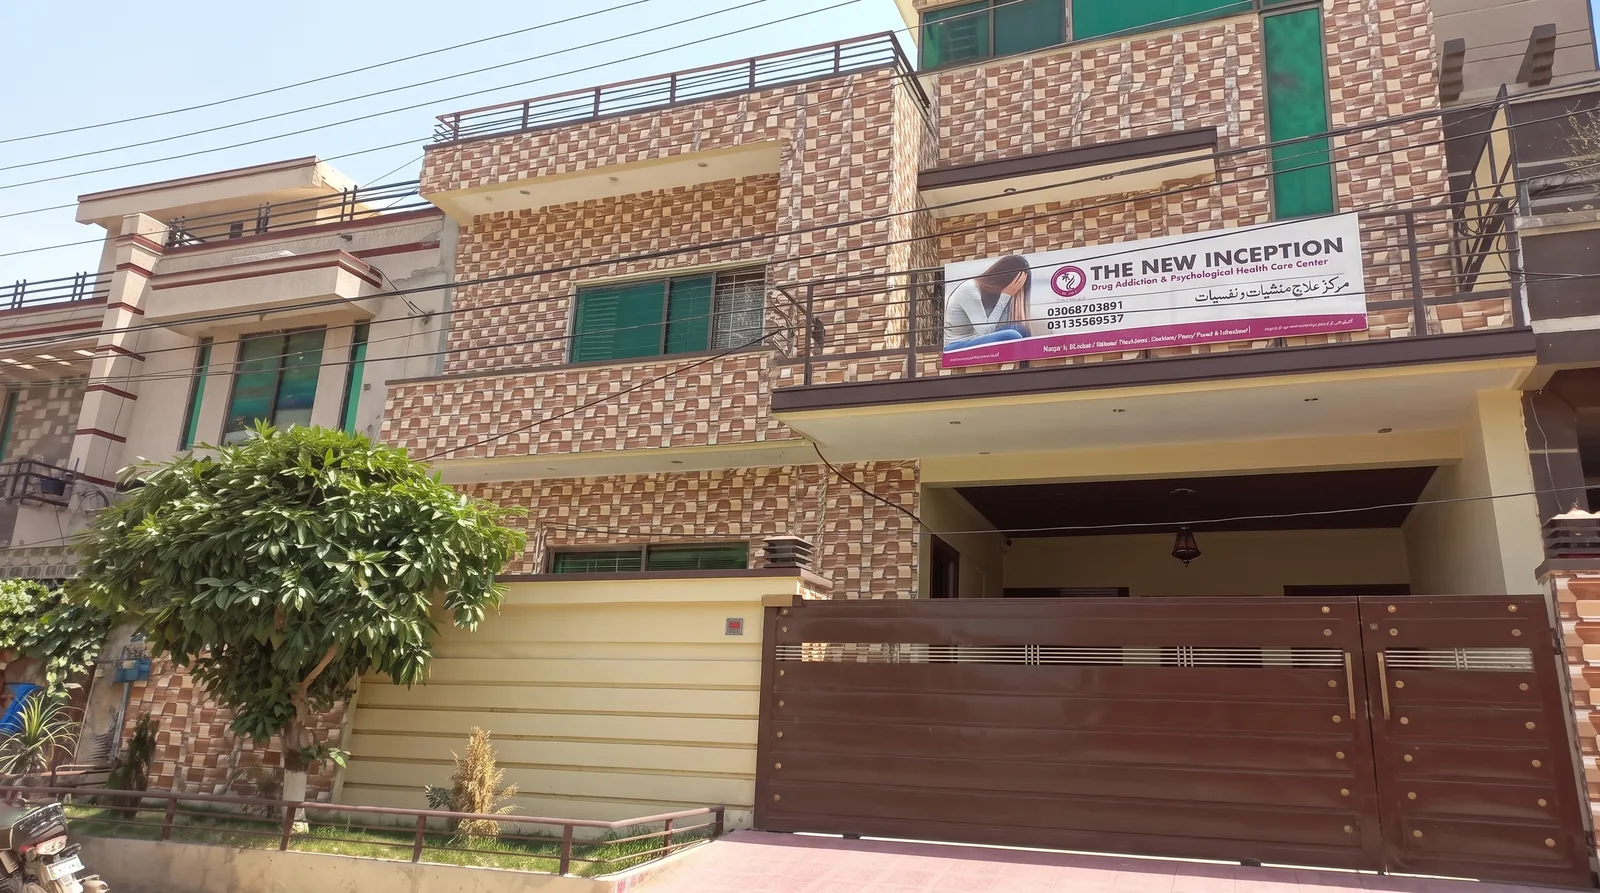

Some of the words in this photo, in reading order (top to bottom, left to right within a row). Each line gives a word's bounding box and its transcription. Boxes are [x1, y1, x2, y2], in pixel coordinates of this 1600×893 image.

[1090, 262, 1134, 281] THE
[1141, 254, 1197, 275] NEW
[1205, 237, 1344, 268] INCEPTION
[1091, 283, 1113, 291] Drug
[1115, 277, 1158, 289] Addiction
[1160, 275, 1168, 283] &
[1170, 267, 1234, 283] Psychological
[1236, 264, 1268, 275] Health
[1270, 263, 1294, 272] Care
[1295, 258, 1329, 268] Center
[1245, 283, 1291, 300] منشیات
[1291, 280, 1320, 297] علاج
[1321, 276, 1350, 294] مرکز
[1194, 287, 1239, 304] نفسیات
[1047, 300, 1123, 317] 03068703891
[1047, 313, 1125, 330] 03135569537
